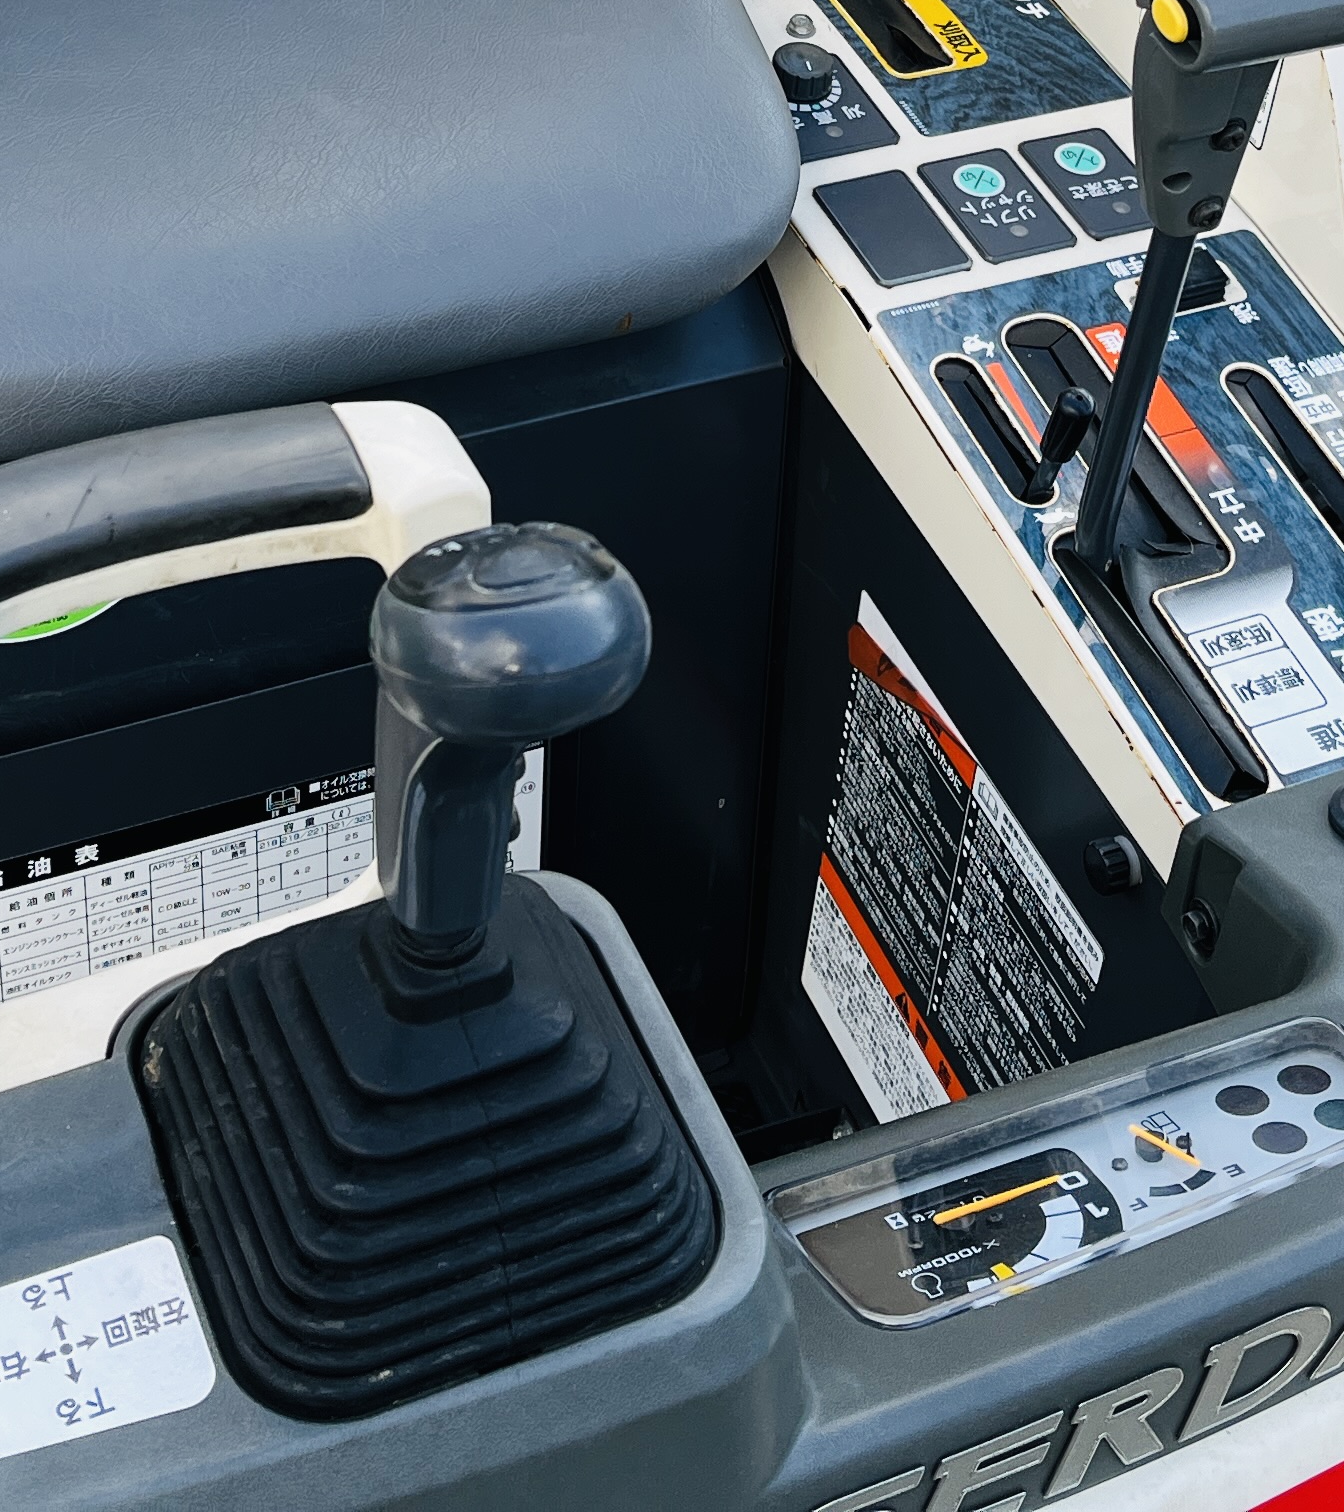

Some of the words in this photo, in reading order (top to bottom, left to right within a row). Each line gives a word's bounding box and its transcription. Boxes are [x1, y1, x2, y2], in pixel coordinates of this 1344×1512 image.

[933, 19, 983, 63] 刈取入
[959, 188, 1035, 215] シャット
[1067, 174, 1139, 201] こぎ深さ
[979, 205, 1038, 228] リフト
[1301, 398, 1338, 421] 中立
[1209, 487, 1266, 544] 中立
[1200, 622, 1273, 659] 低速刈
[1230, 665, 1306, 705] 標準刈
[1222, 1163, 1246, 1178] E
[1128, 1196, 1149, 1212] F
[21, 1271, 74, 1311] 上る
[101, 1296, 190, 1349] 左旋回
[56, 1387, 116, 1426] 下る
